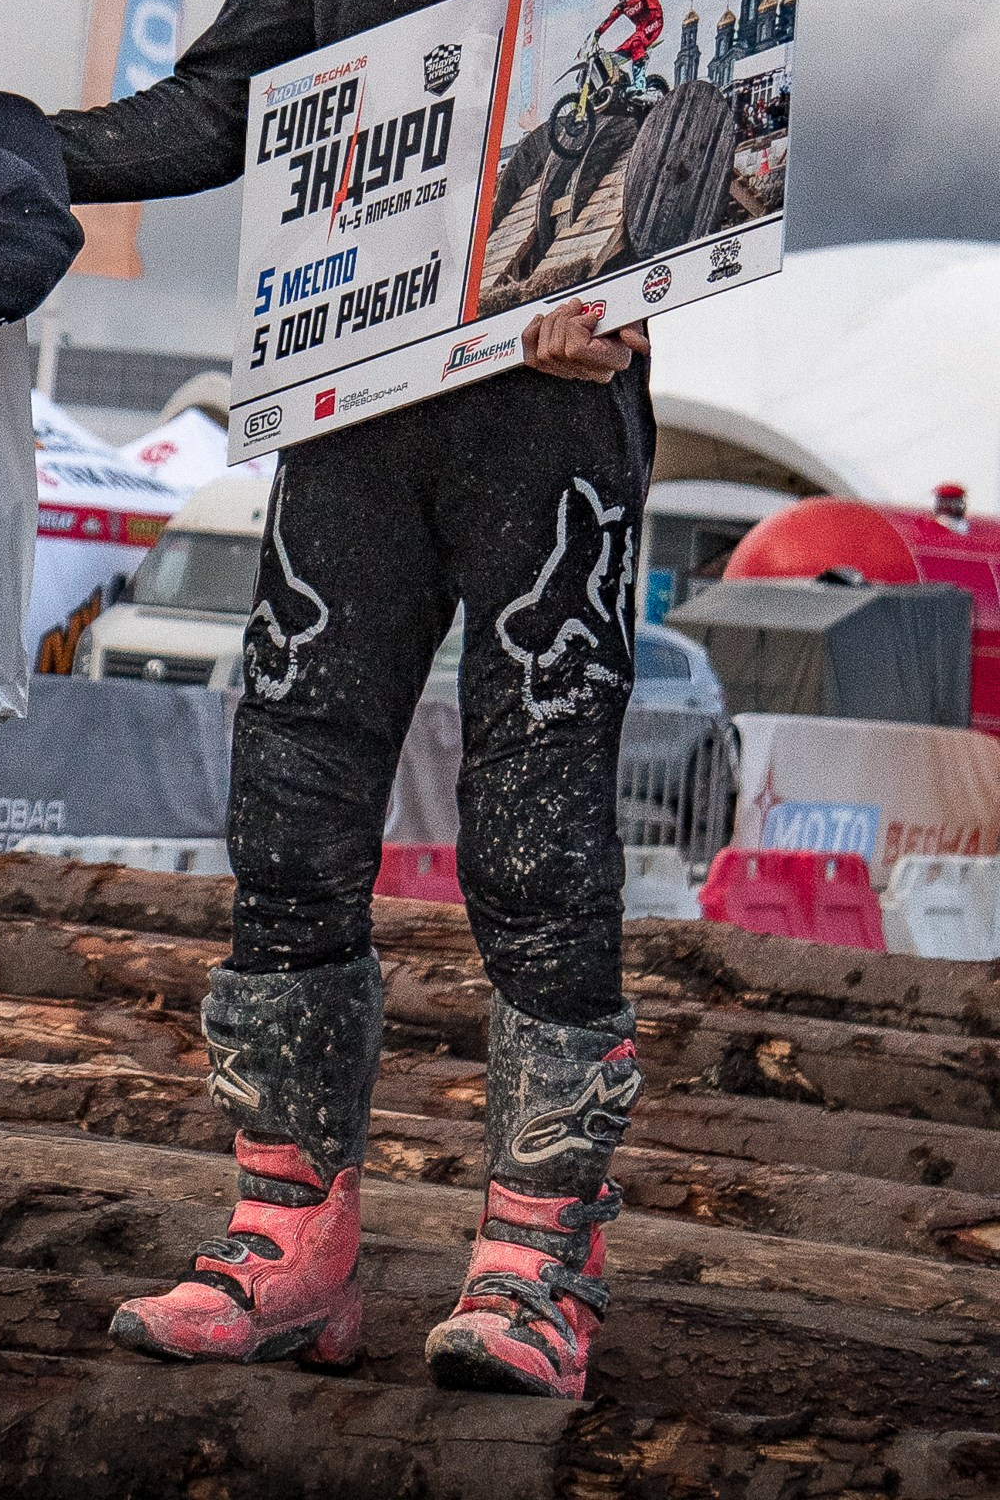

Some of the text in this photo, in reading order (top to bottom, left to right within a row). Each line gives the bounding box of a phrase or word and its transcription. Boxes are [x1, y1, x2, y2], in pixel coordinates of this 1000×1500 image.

[257, 77, 359, 165] СУПЕР
[281, 97, 455, 225] ЭНДУРО
[338, 178, 448, 233] 4-5 АПРЕЛЯ 2026
[254, 246, 358, 317] 5 МЕСТО
[250, 250, 442, 370] 5 000 РУБЛЕЙ
[446, 336, 519, 371] ДВИЖЕНИЕ
[493, 349, 515, 362] УРАЛ
[338, 388, 369, 405] НОВАЯ
[338, 382, 409, 413] ПЕРЕВОЗОЧНАЯ
[250, 411, 278, 433] БТС
